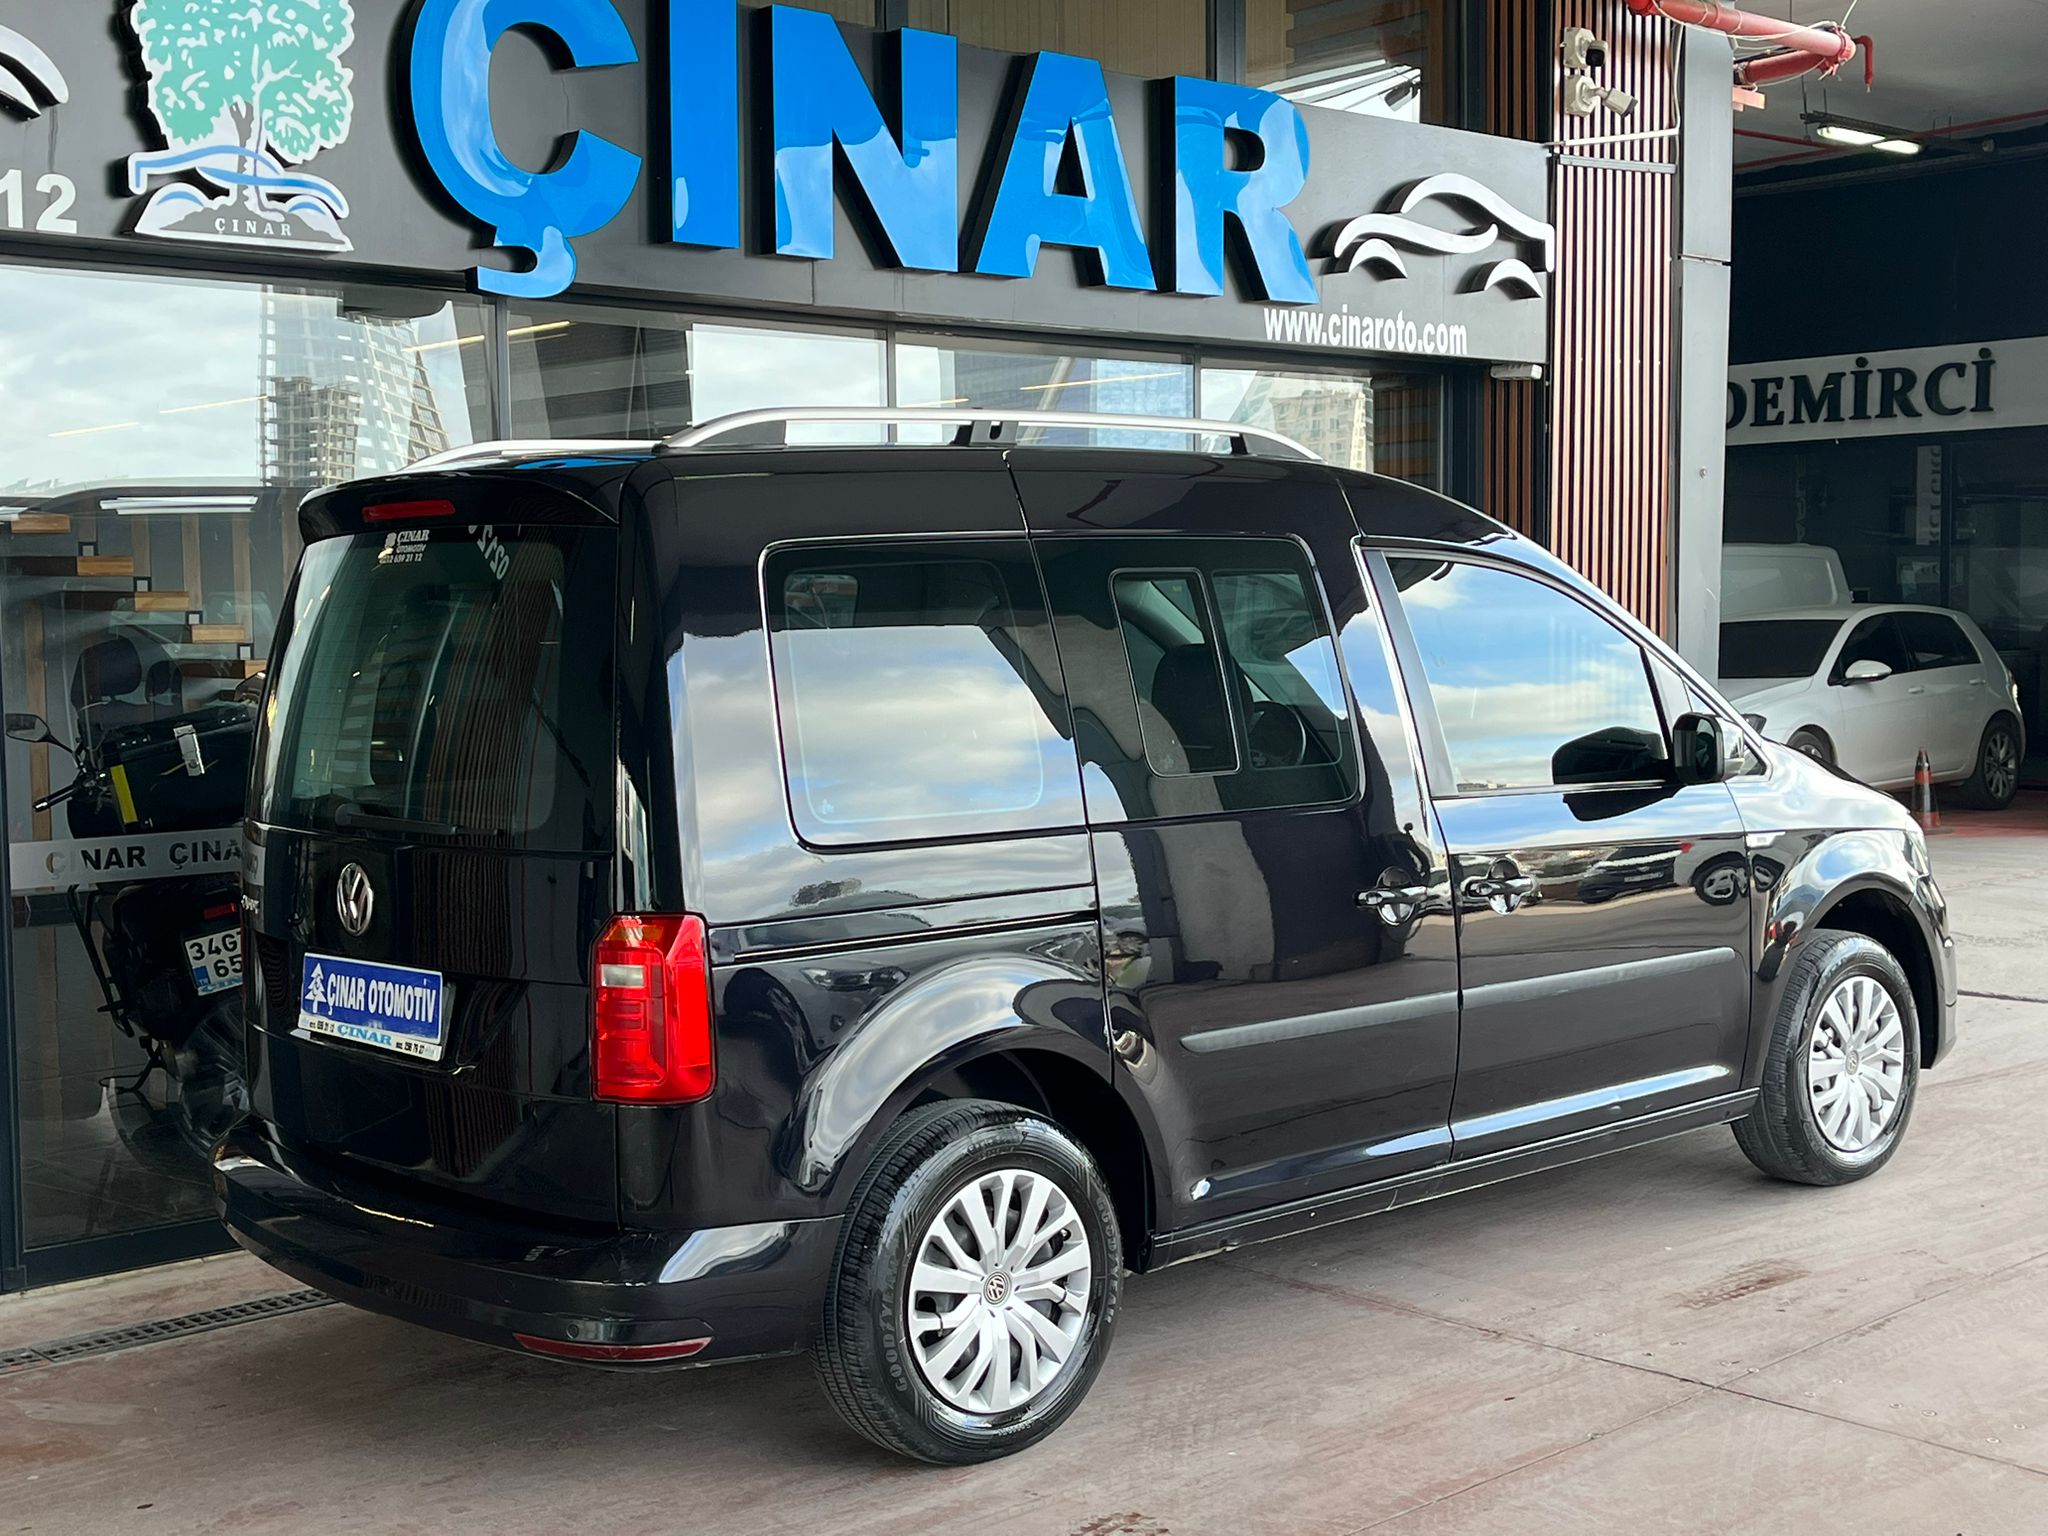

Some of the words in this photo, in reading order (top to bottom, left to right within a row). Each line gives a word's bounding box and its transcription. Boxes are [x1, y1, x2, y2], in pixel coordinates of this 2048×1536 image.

[410, 0, 1318, 304] ÇINAR
[0, 169, 77, 234] 12
[214, 217, 292, 236] ÇINAR
[1264, 304, 1468, 355] www.cinaroto.com
[327, 973, 366, 1016] ÇINAR
[368, 978, 437, 1023] OTOMOTİV
[337, 1024, 393, 1046] ÇINAR
